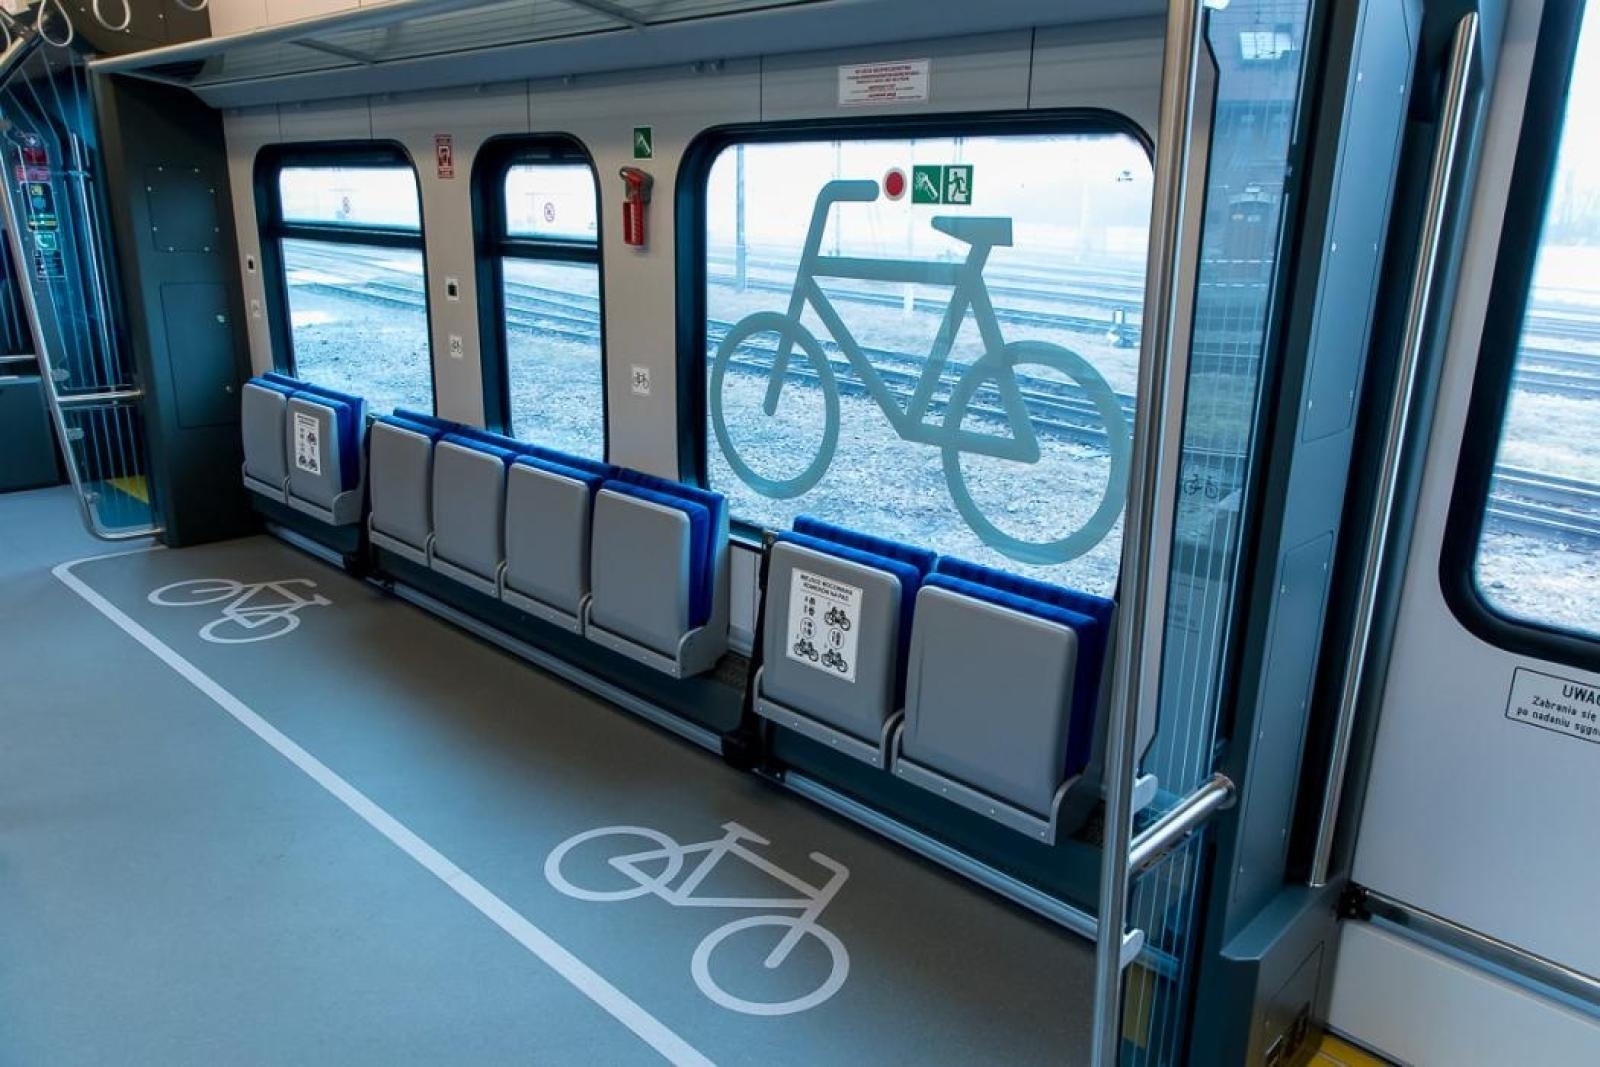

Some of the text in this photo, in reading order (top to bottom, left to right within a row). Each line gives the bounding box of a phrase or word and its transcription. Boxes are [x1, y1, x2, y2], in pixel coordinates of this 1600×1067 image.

[1516, 706, 1529, 717] po
[1532, 710, 1571, 728] nadaniu
[1532, 695, 1597, 722] Zabrania się
